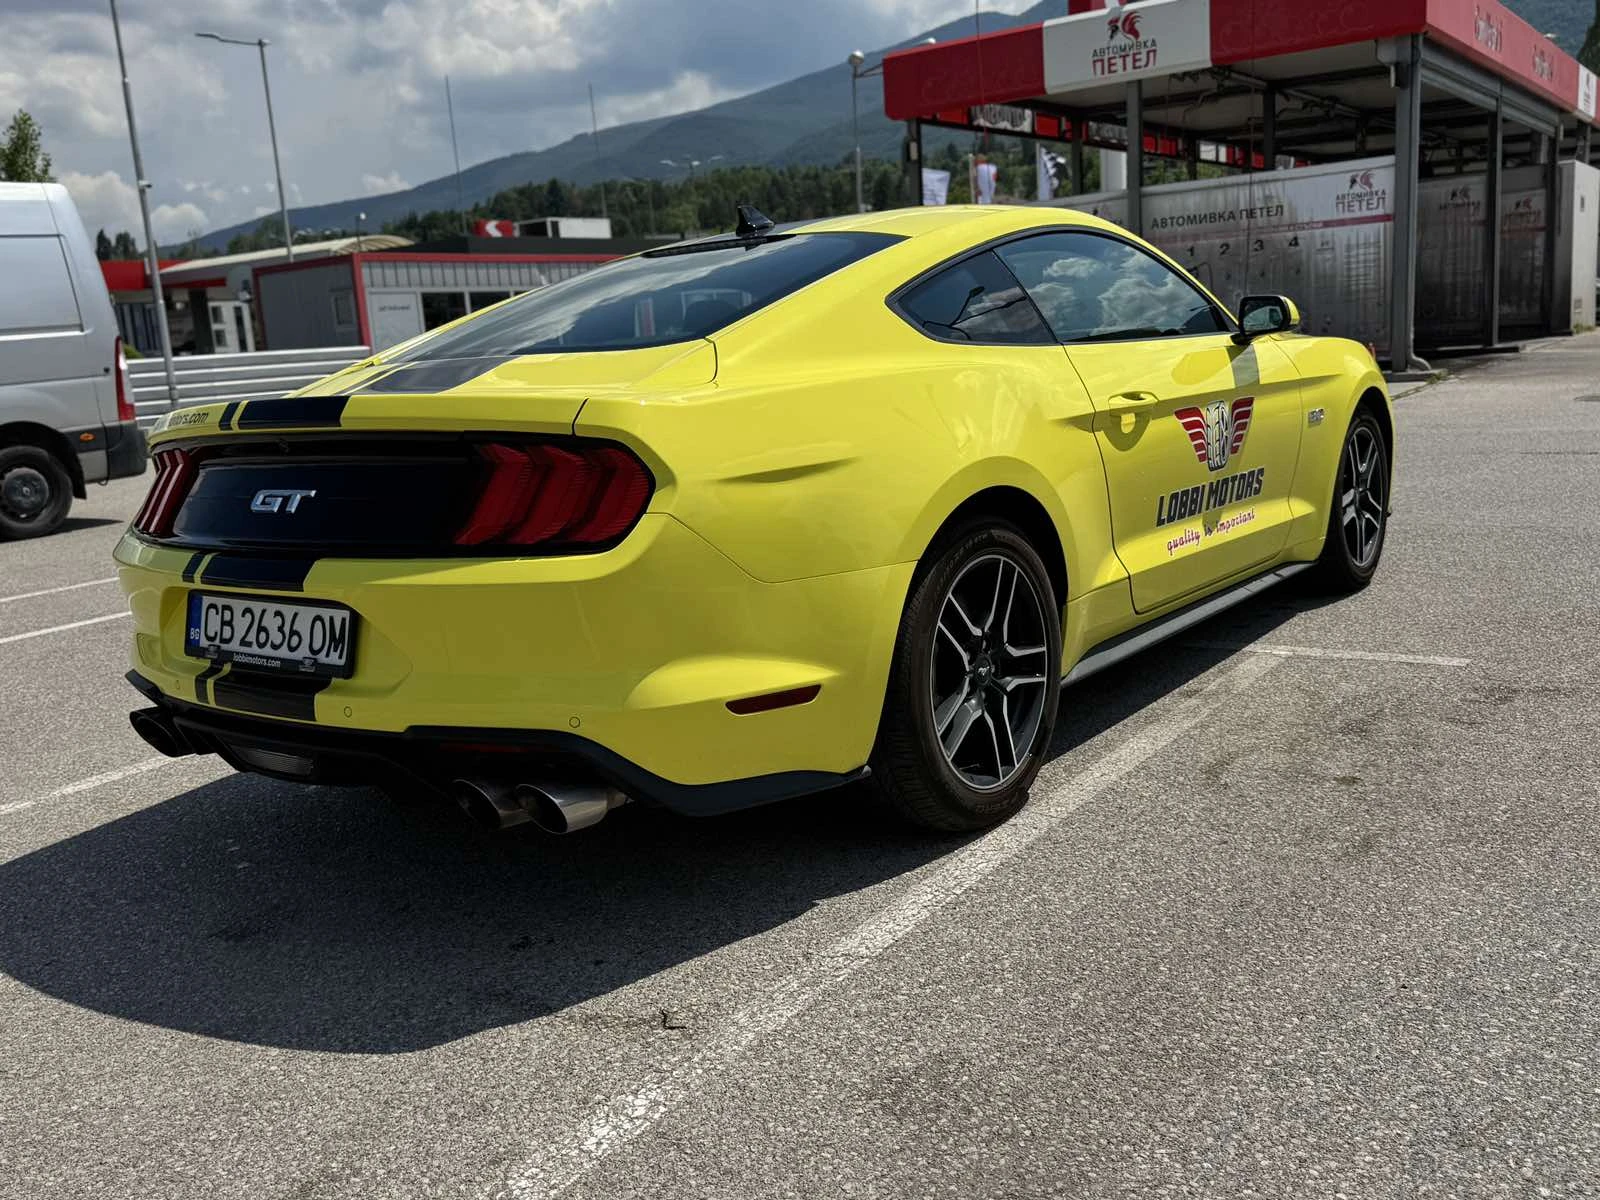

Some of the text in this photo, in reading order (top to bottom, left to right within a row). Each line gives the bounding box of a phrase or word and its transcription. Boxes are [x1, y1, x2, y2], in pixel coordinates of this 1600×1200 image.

[1091, 38, 1157, 58] АВТОМИВКА
[1092, 49, 1157, 76] ПЕТЕЛ
[1151, 204, 1284, 230] АВТОМИВКА ПЕТЕЛ
[1336, 197, 1386, 213] ПЕТЕЛ
[1187, 236, 1299, 257] 1 2 3 4
[250, 490, 317, 514] GT
[1156, 468, 1265, 527] LOBBI MOTORS
[1167, 529, 1201, 556] quality
[1215, 508, 1256, 534] important
[190, 627, 200, 640] BG
[204, 603, 235, 646] CB
[240, 607, 304, 652] 2636
[232, 653, 281, 668] lobbimotors.com
